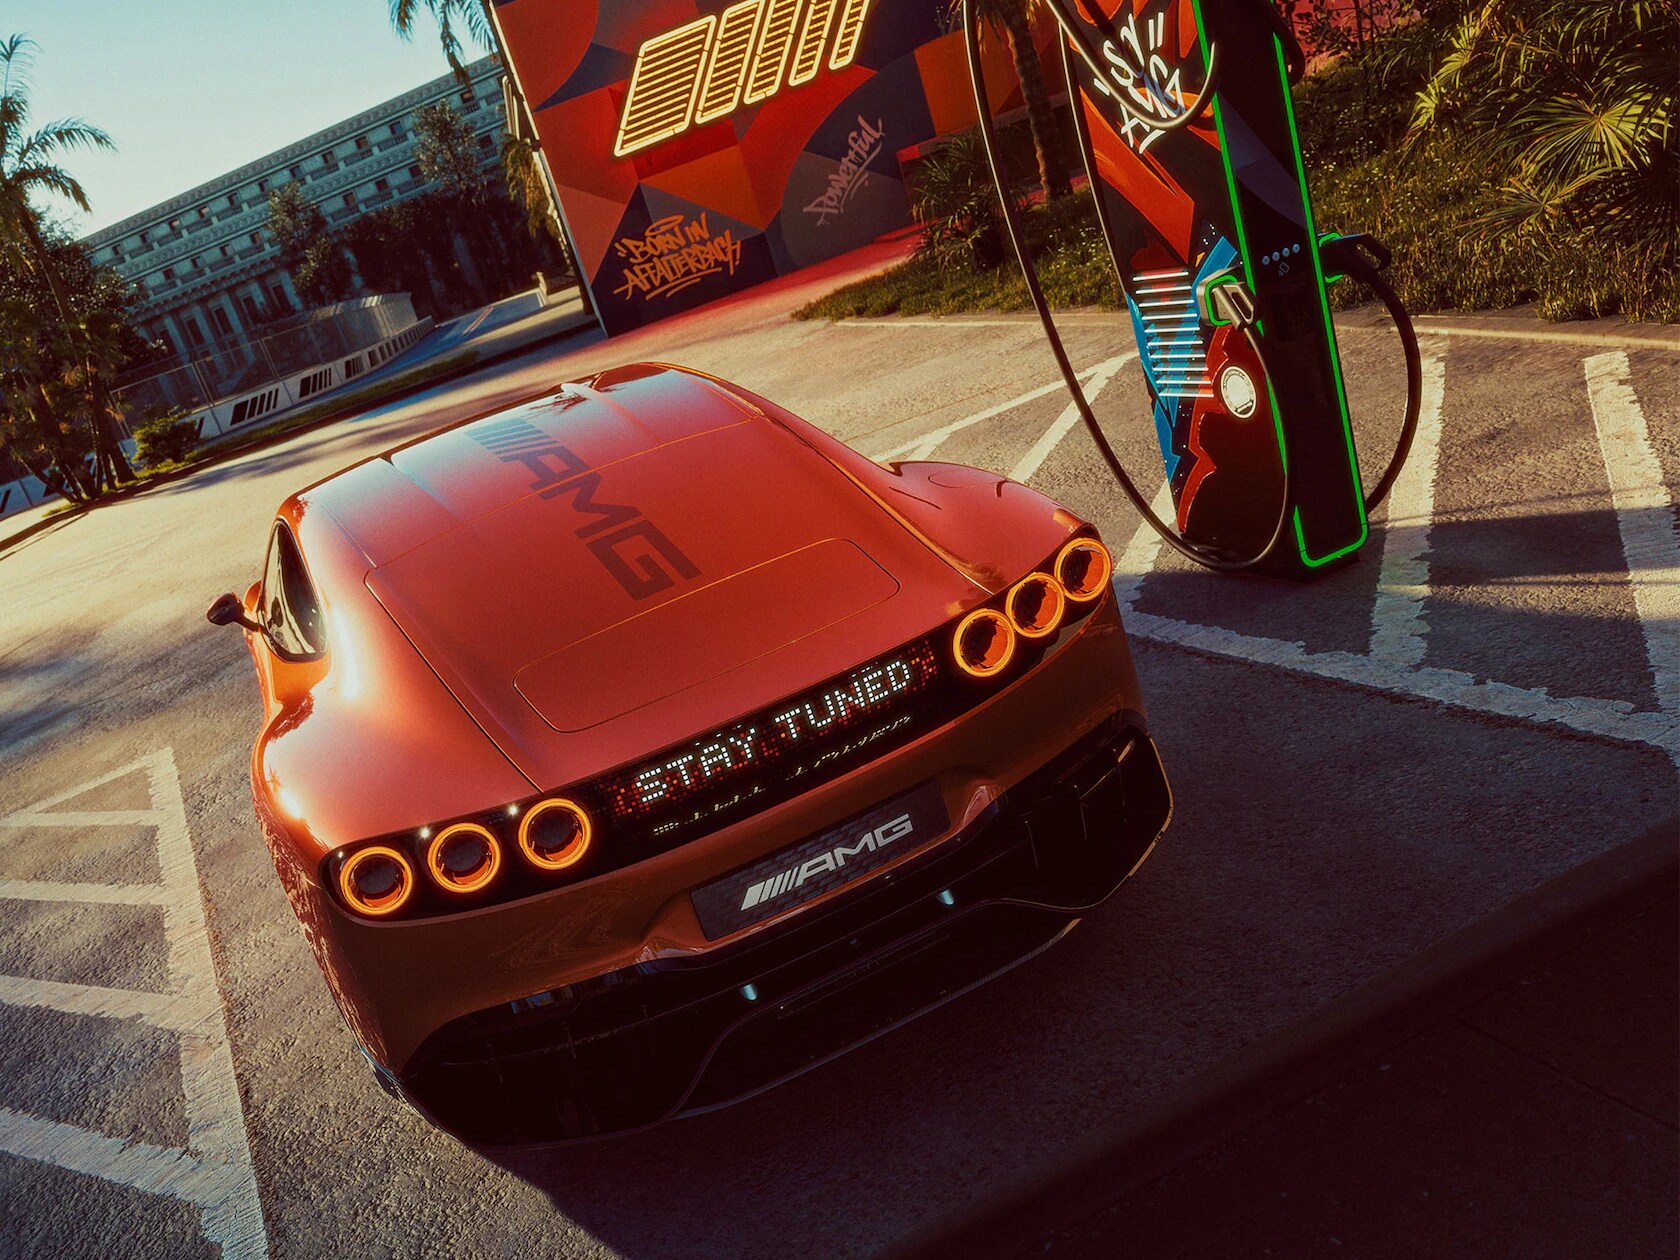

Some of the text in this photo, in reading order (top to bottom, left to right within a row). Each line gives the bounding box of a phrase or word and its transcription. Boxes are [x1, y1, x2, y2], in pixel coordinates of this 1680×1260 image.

[803, 114, 886, 225] Powerful
[684, 211, 711, 243] IN
[500, 445, 702, 601] AMG
[635, 660, 912, 803] STAY TUNED
[794, 813, 914, 888] AMG
